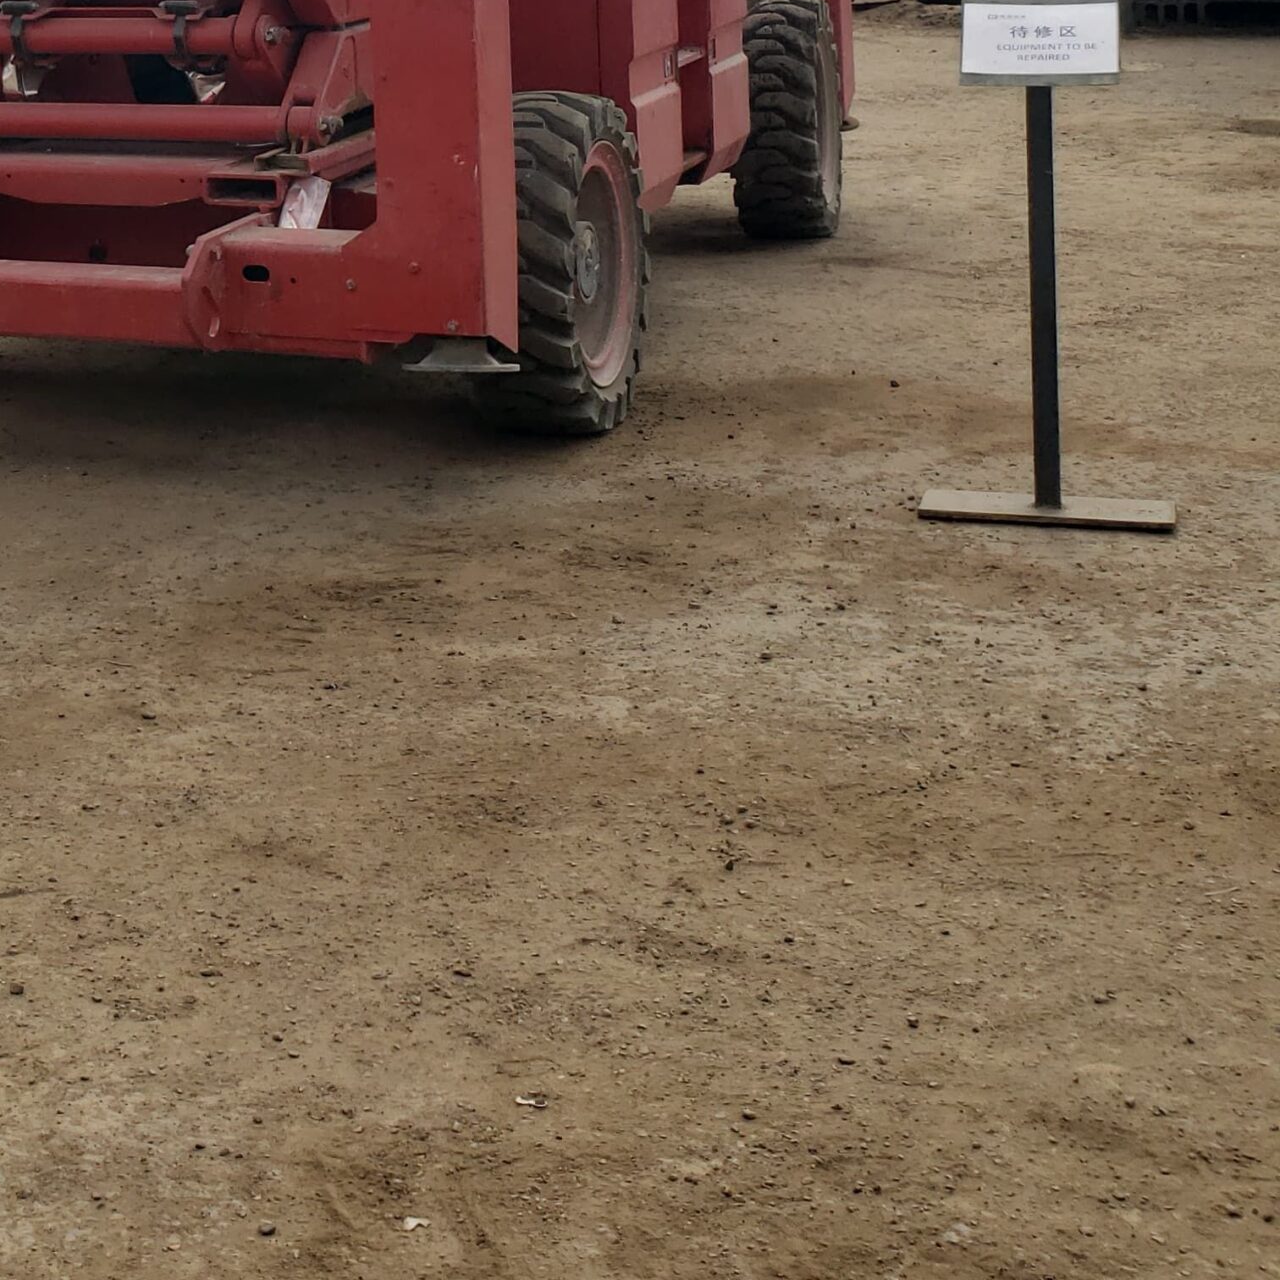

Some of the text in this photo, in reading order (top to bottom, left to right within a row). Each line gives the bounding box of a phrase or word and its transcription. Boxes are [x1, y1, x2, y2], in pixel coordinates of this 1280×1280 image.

[1009, 25, 1077, 39] 待修区
[996, 42, 1097, 52] EQUIPMENT TO BE
[1016, 53, 1071, 62] REPAIRED
